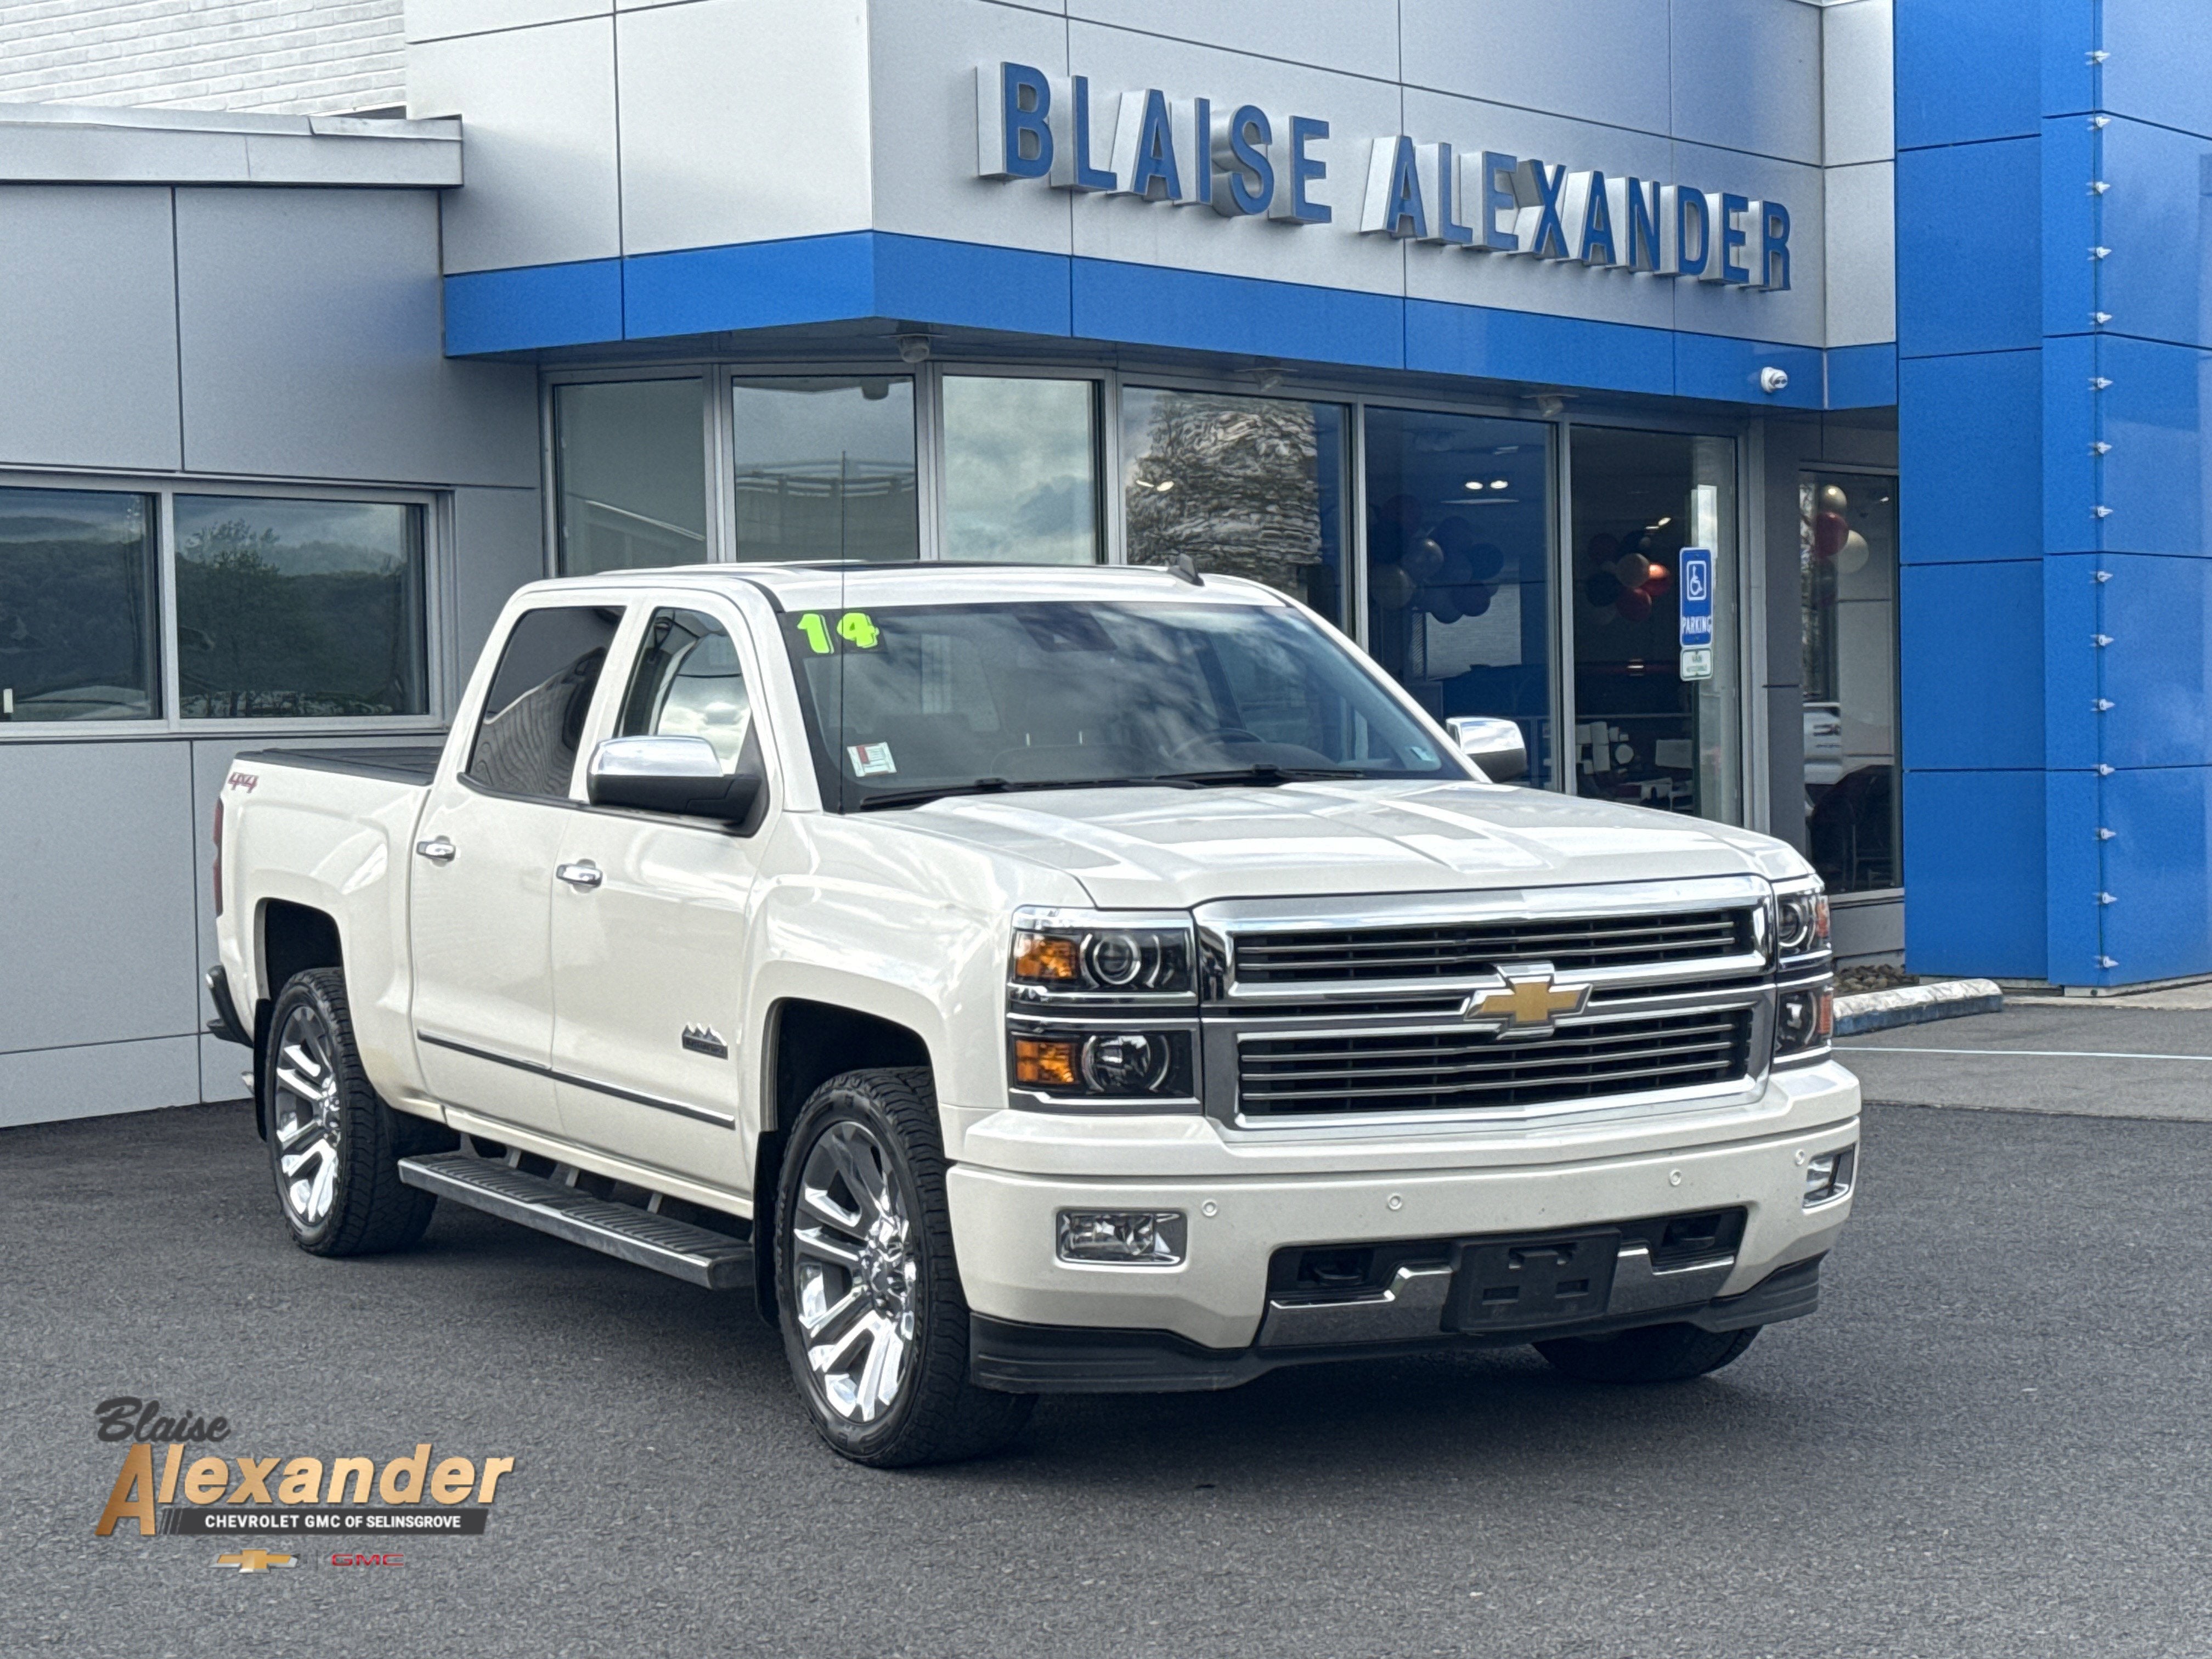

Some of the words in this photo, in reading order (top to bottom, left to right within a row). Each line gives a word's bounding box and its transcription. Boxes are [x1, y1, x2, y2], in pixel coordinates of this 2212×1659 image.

[1000, 61, 1332, 224] BLAISE
[1385, 135, 1791, 291] ALEXANDER
[797, 613, 880, 654] 14
[1681, 616, 1712, 634] PARKING
